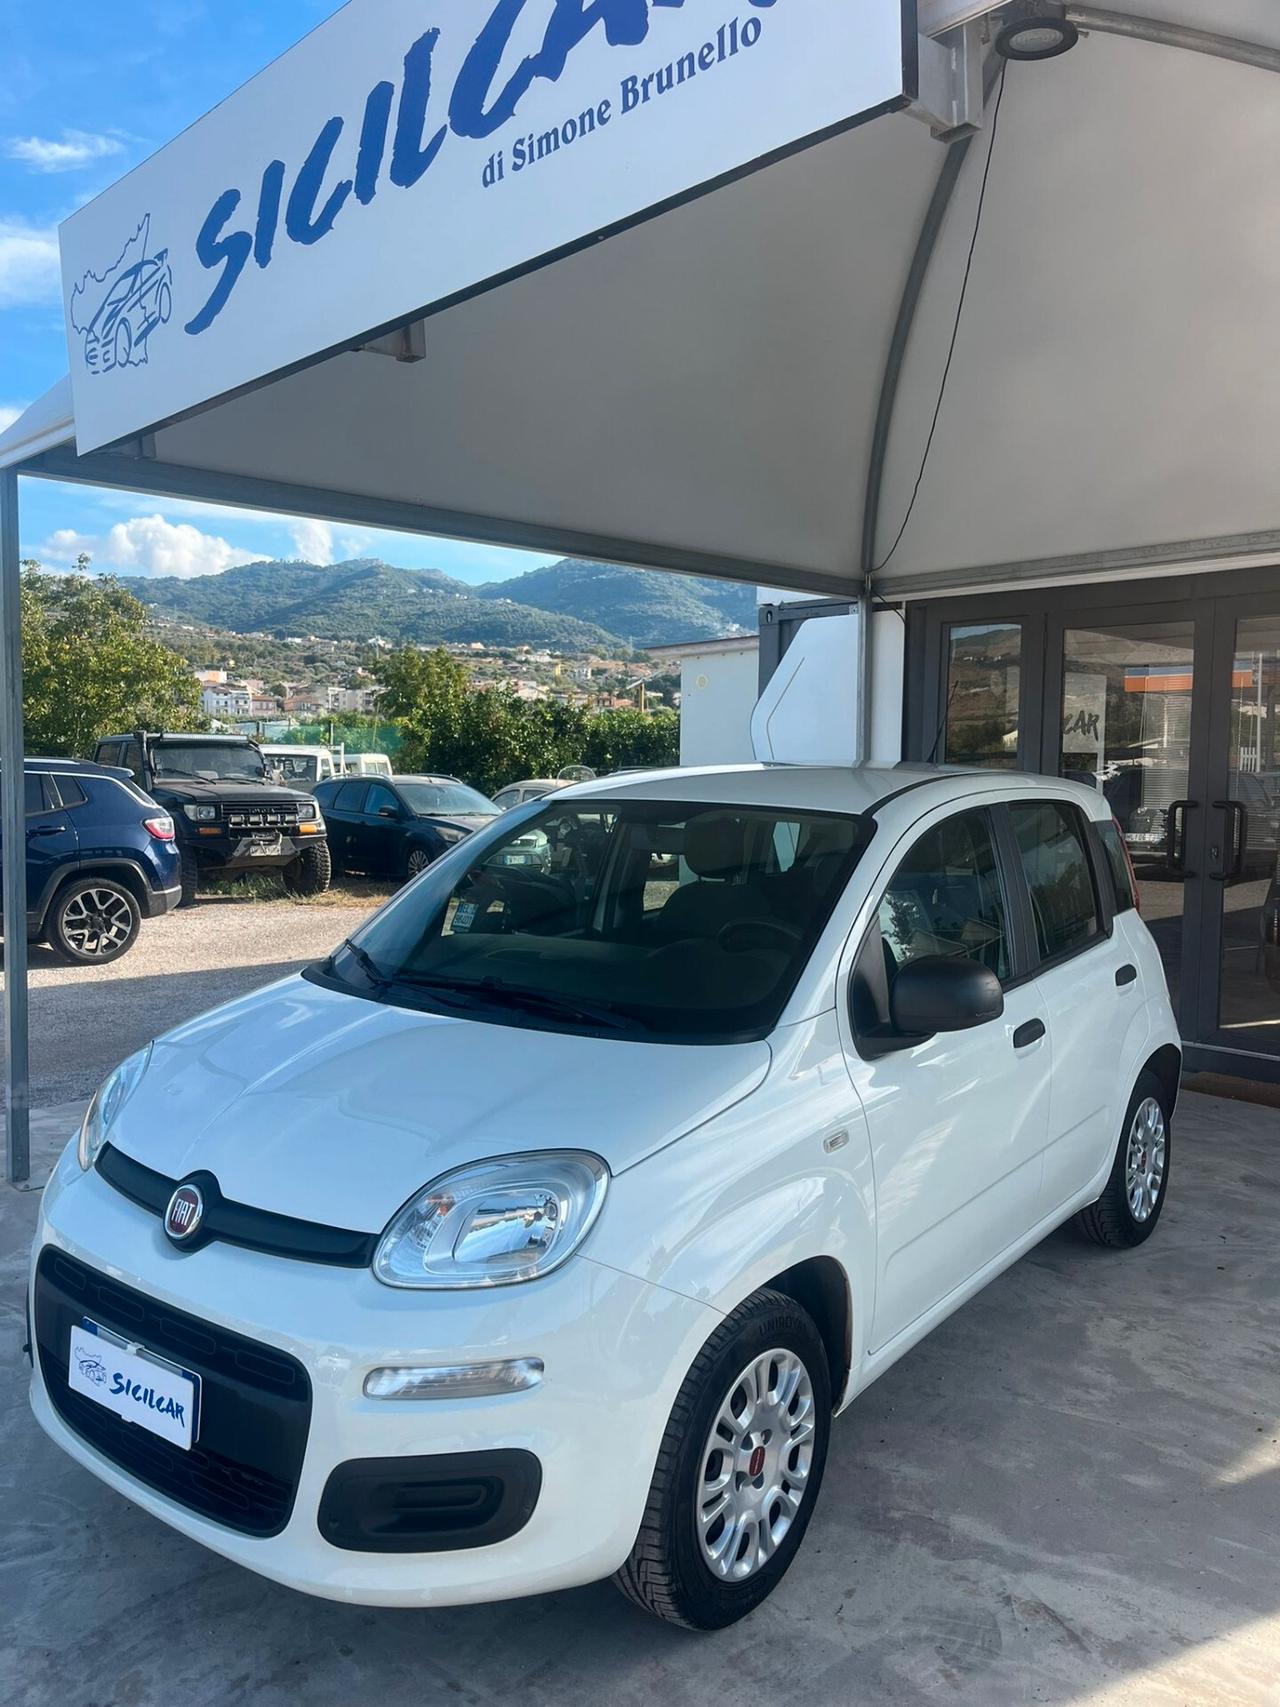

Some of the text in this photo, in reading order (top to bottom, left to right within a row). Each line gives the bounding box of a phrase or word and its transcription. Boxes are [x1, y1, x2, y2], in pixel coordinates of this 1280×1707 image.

[482, 16, 762, 188] di Simone Brunello
[184, 0, 778, 335] SICILC
[171, 1198, 195, 1226] FIAT
[109, 1372, 185, 1428] SICILCAR
